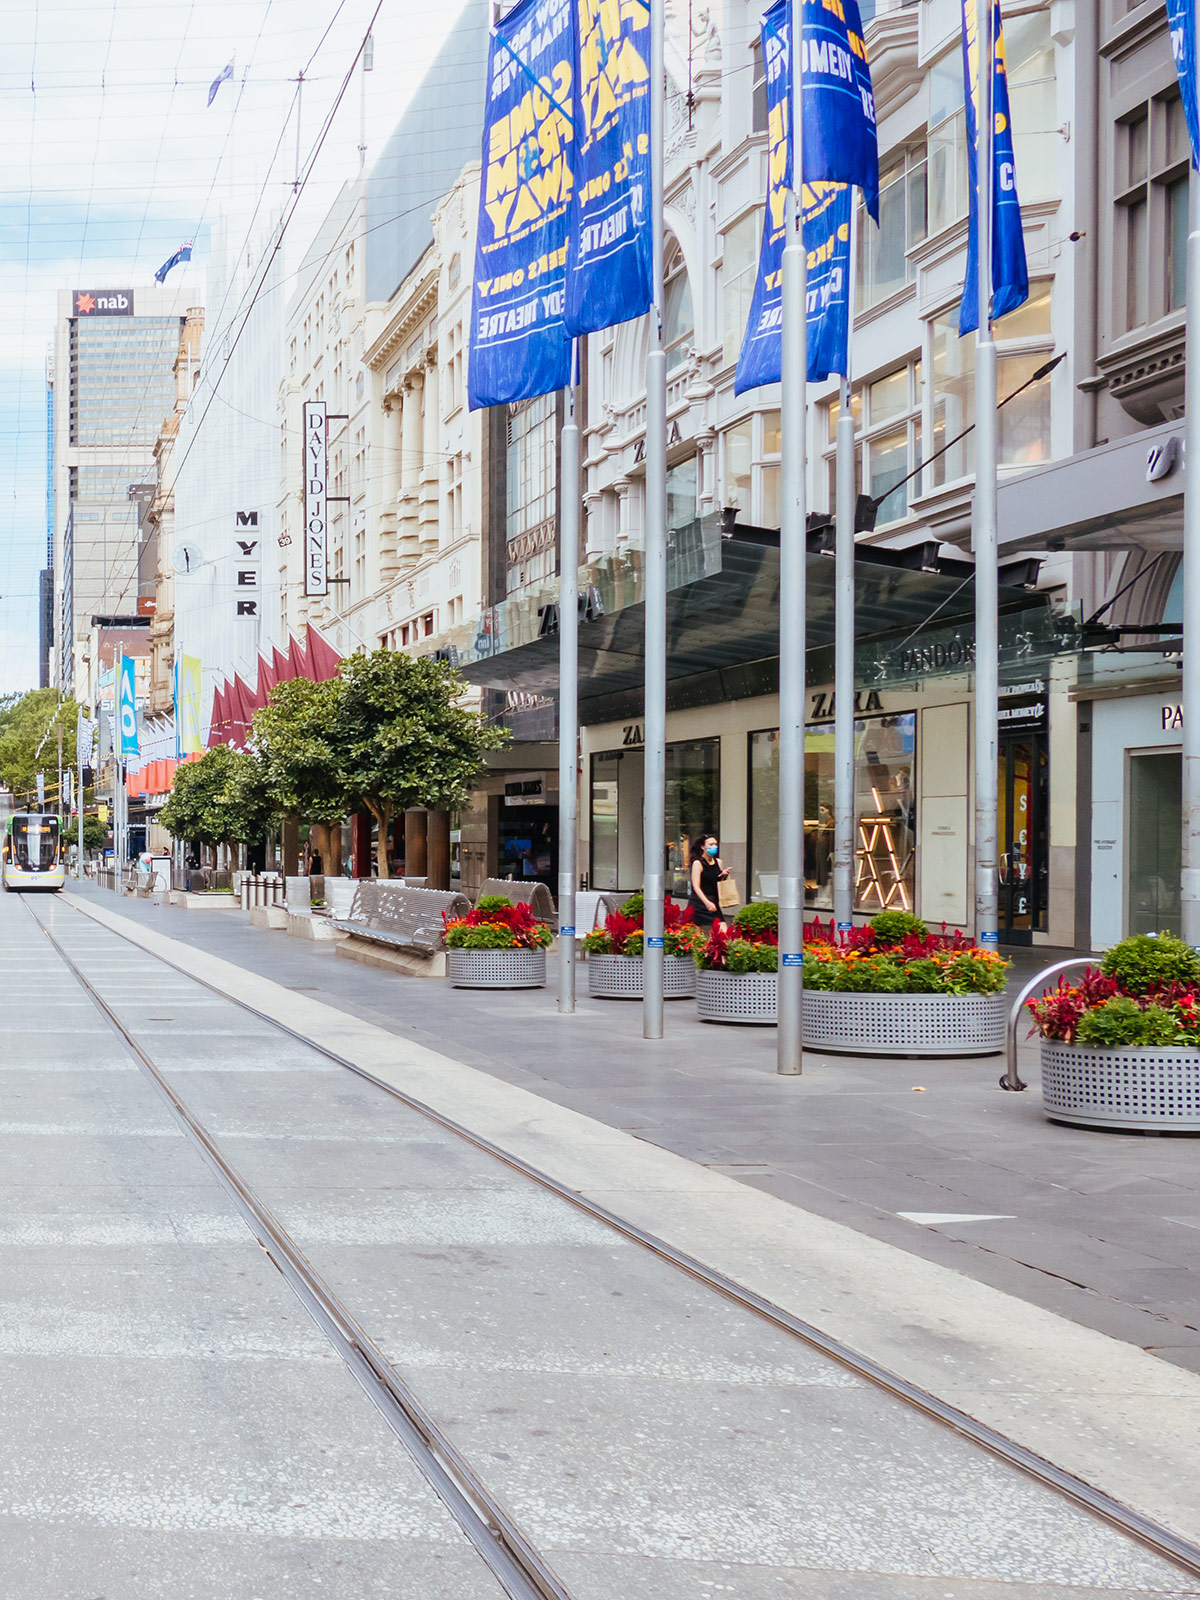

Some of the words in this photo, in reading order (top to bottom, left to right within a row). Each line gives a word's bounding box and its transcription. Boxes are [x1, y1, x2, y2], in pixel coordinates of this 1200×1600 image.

[97, 294, 129, 309] nab
[309, 413, 324, 495] DAVID
[633, 420, 682, 465] ZA
[236, 511, 259, 616] MYER
[309, 500, 324, 587] JONES
[902, 637, 976, 673] PANDOR
